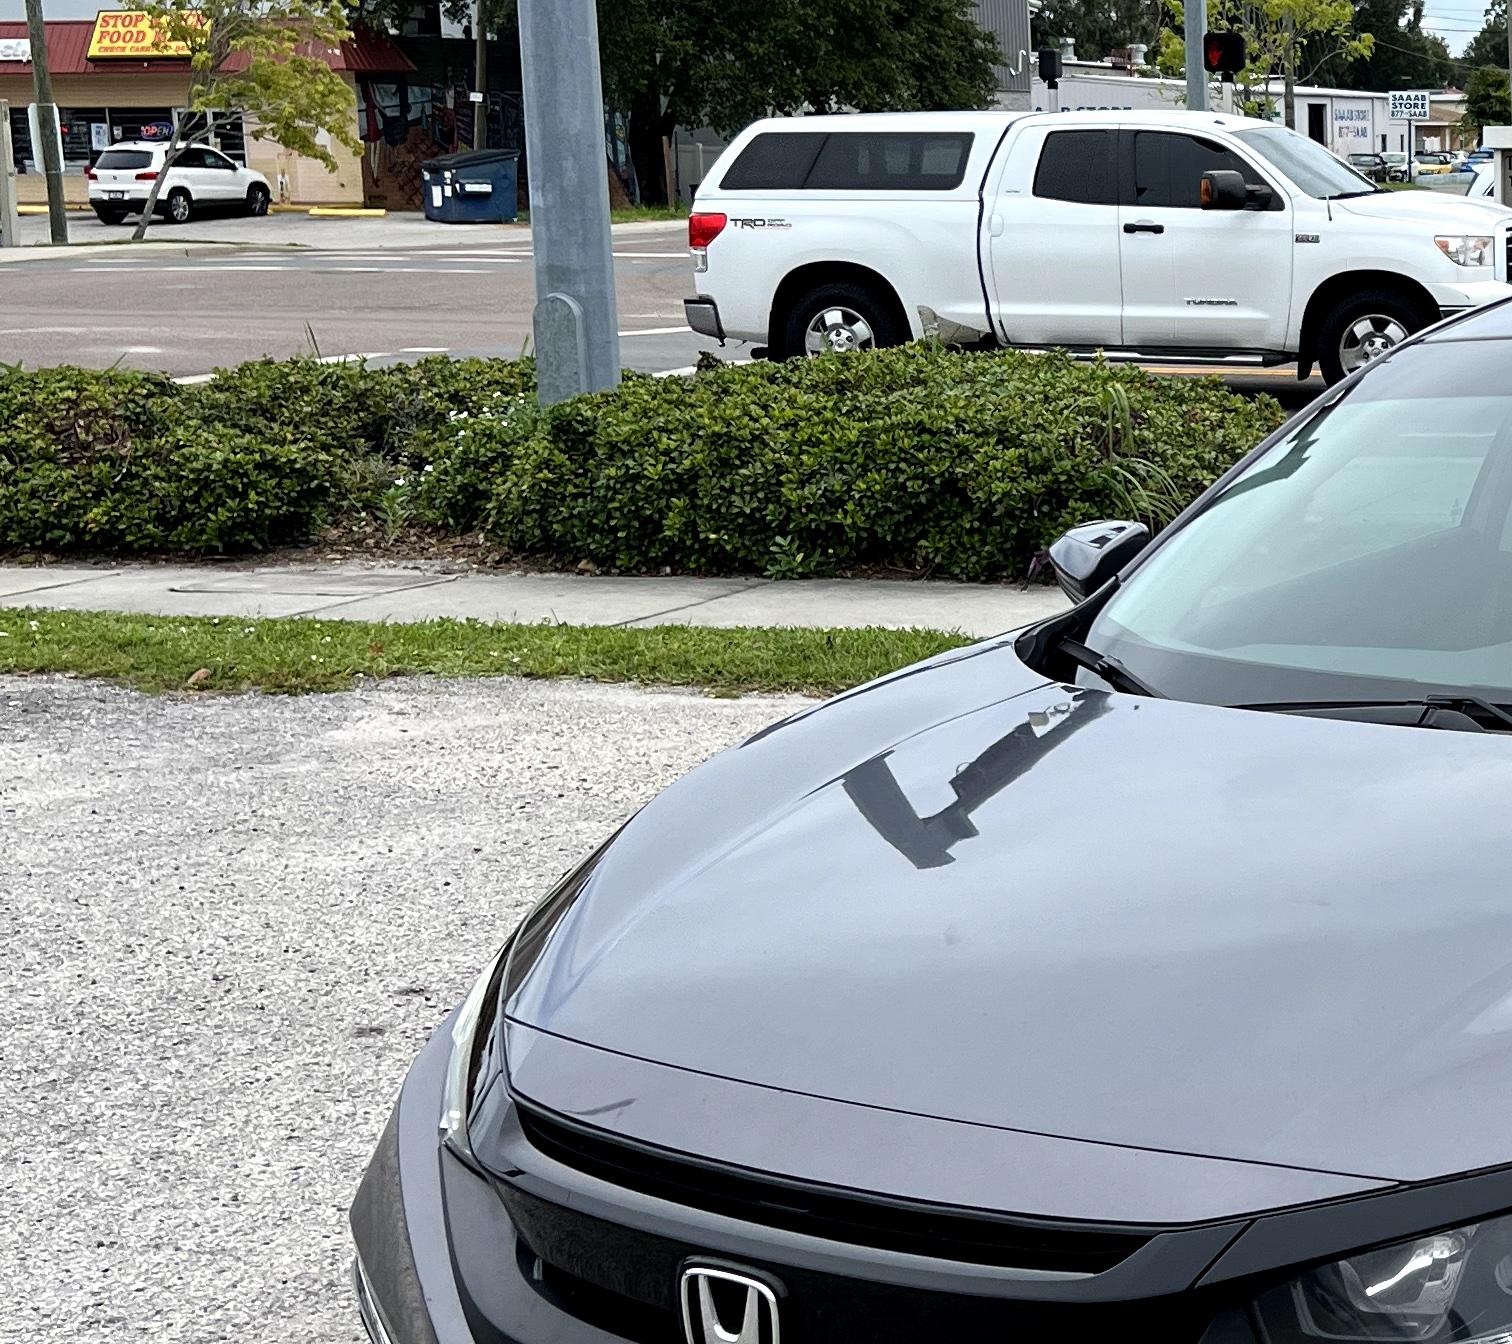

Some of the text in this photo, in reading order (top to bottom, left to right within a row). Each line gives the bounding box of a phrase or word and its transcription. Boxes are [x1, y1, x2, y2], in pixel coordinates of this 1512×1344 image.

[100, 14, 145, 29] STOP
[97, 30, 146, 44] FOOD
[1391, 94, 1427, 102] SAAAB
[1391, 102, 1427, 110] STORE
[729, 218, 766, 230] TRD
